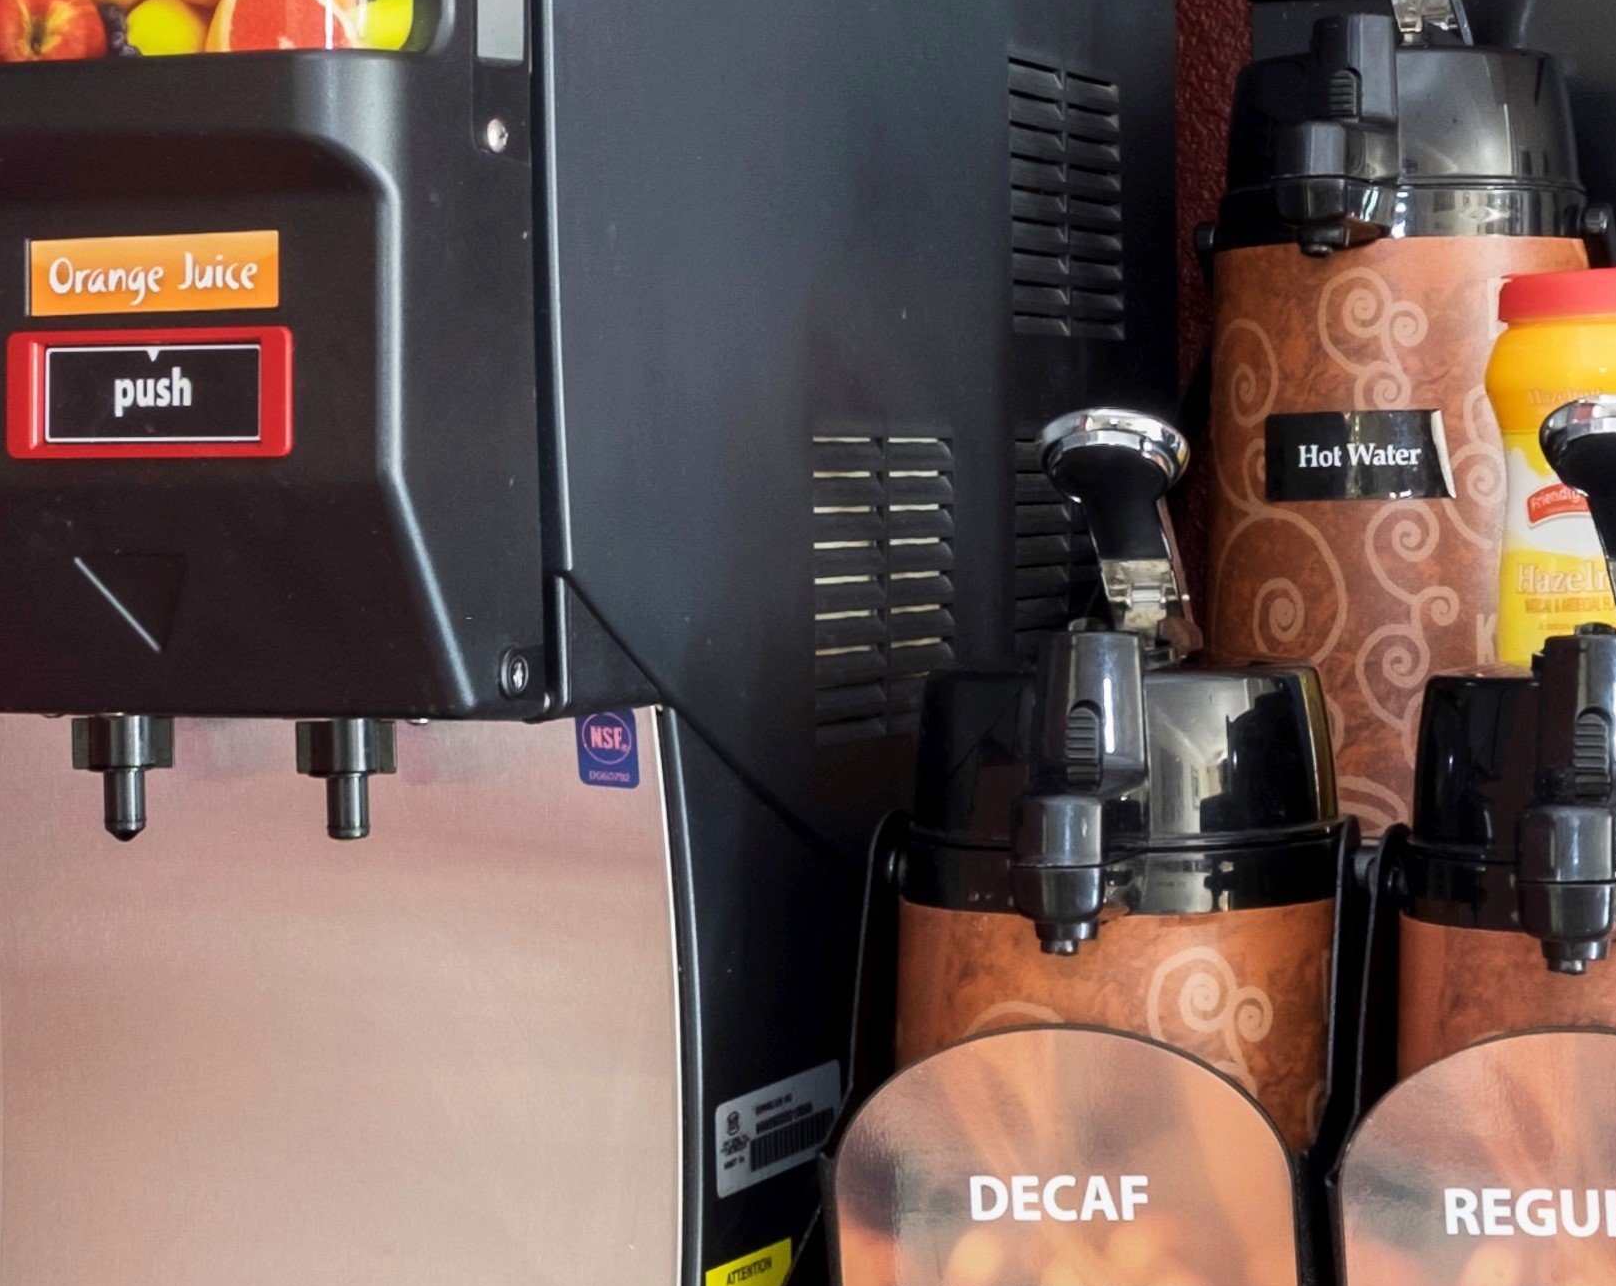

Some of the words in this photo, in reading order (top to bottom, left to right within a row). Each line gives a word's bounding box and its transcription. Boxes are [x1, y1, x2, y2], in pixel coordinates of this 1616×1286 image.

[49, 257, 163, 305] Orange
[178, 252, 258, 290] Juice
[114, 366, 192, 417] push
[1298, 444, 1342, 468] Hot
[1347, 443, 1422, 466] Water
[590, 725, 623, 750] NSF
[969, 1174, 1149, 1222] DECAF
